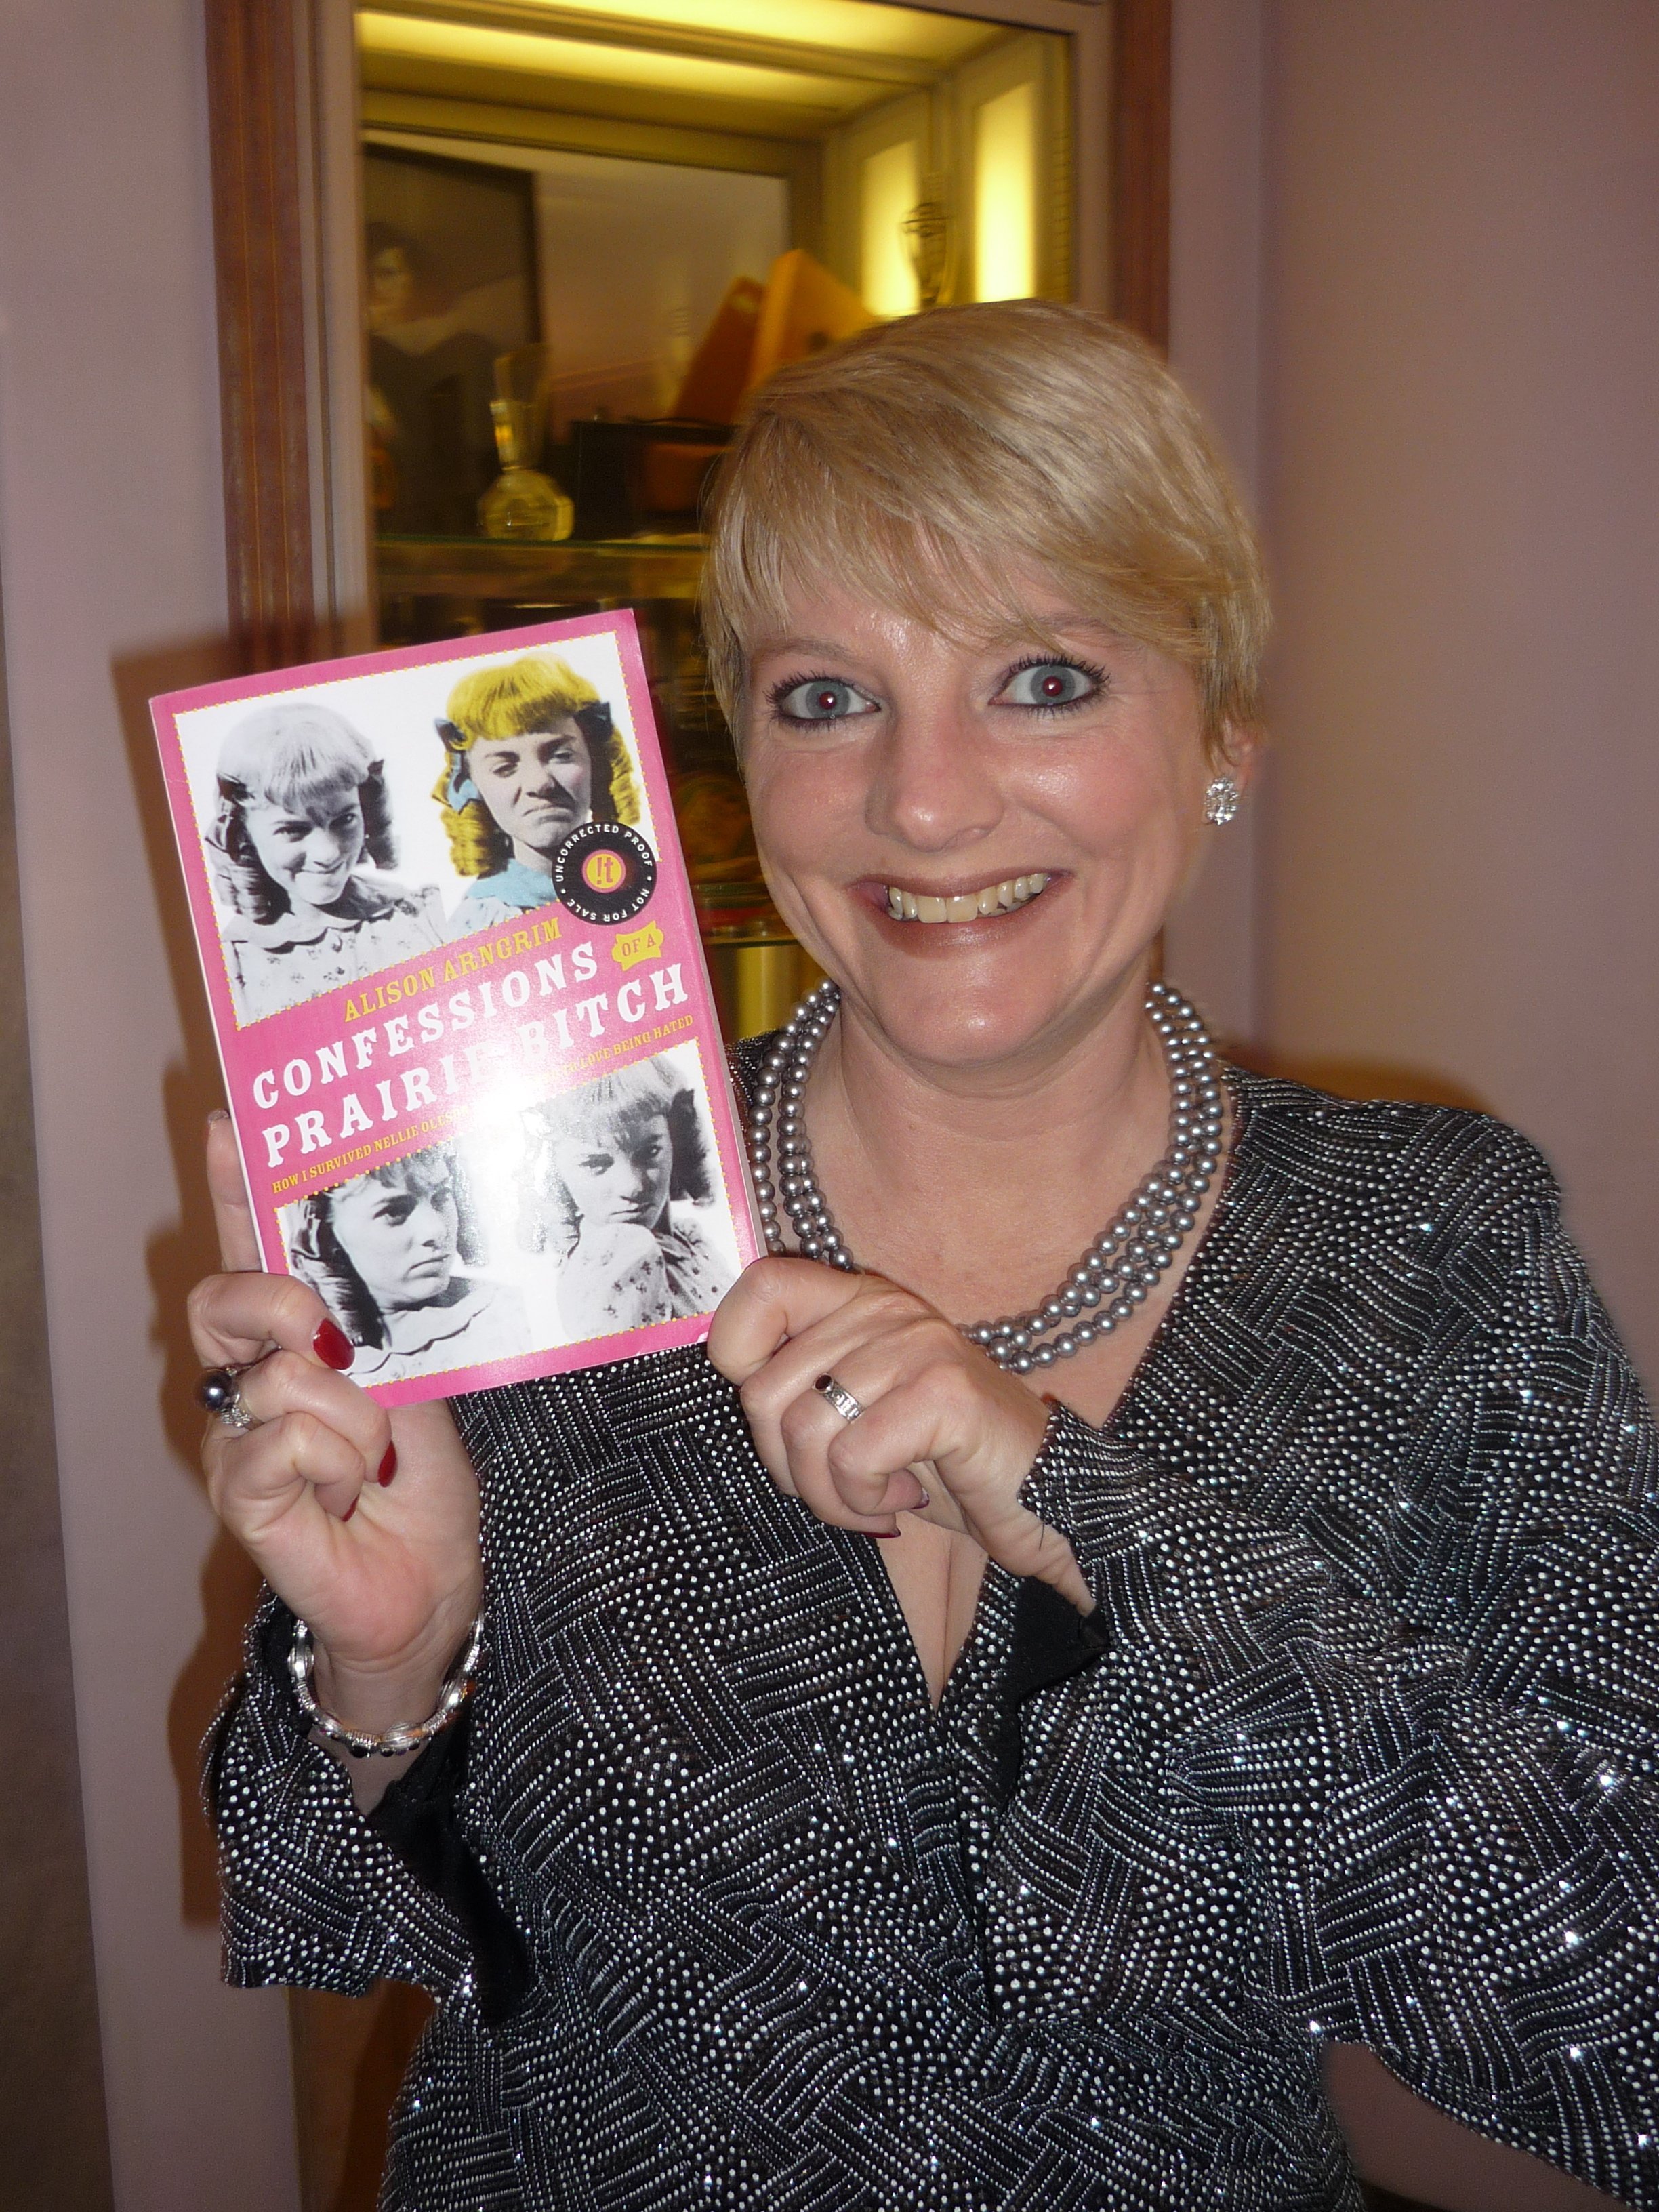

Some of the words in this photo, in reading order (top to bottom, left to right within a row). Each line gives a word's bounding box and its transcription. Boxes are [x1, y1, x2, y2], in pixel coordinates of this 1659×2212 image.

[556, 824, 619, 882] UNCORRECTED
[624, 831, 653, 867] PROOF
[567, 899, 597, 921] SALE
[603, 909, 628, 922] FOR
[631, 888, 650, 912] NOT
[344, 966, 436, 1023] ALISON
[442, 916, 562, 983] ARNGRIM
[253, 940, 599, 1110] CONFESSIONS
[621, 938, 641, 957] OF
[646, 933, 657, 948] A
[262, 1041, 504, 1168] PRAIRIE
[517, 963, 689, 1061] BITCH
[272, 1172, 299, 1194] HOW
[302, 1170, 308, 1183] I
[309, 1144, 372, 1178] SURVIVED
[374, 1125, 419, 1153] NELLIE
[579, 1048, 611, 1069] LOVE
[613, 1034, 652, 1056] BEING
[653, 1015, 694, 1040] HATED
